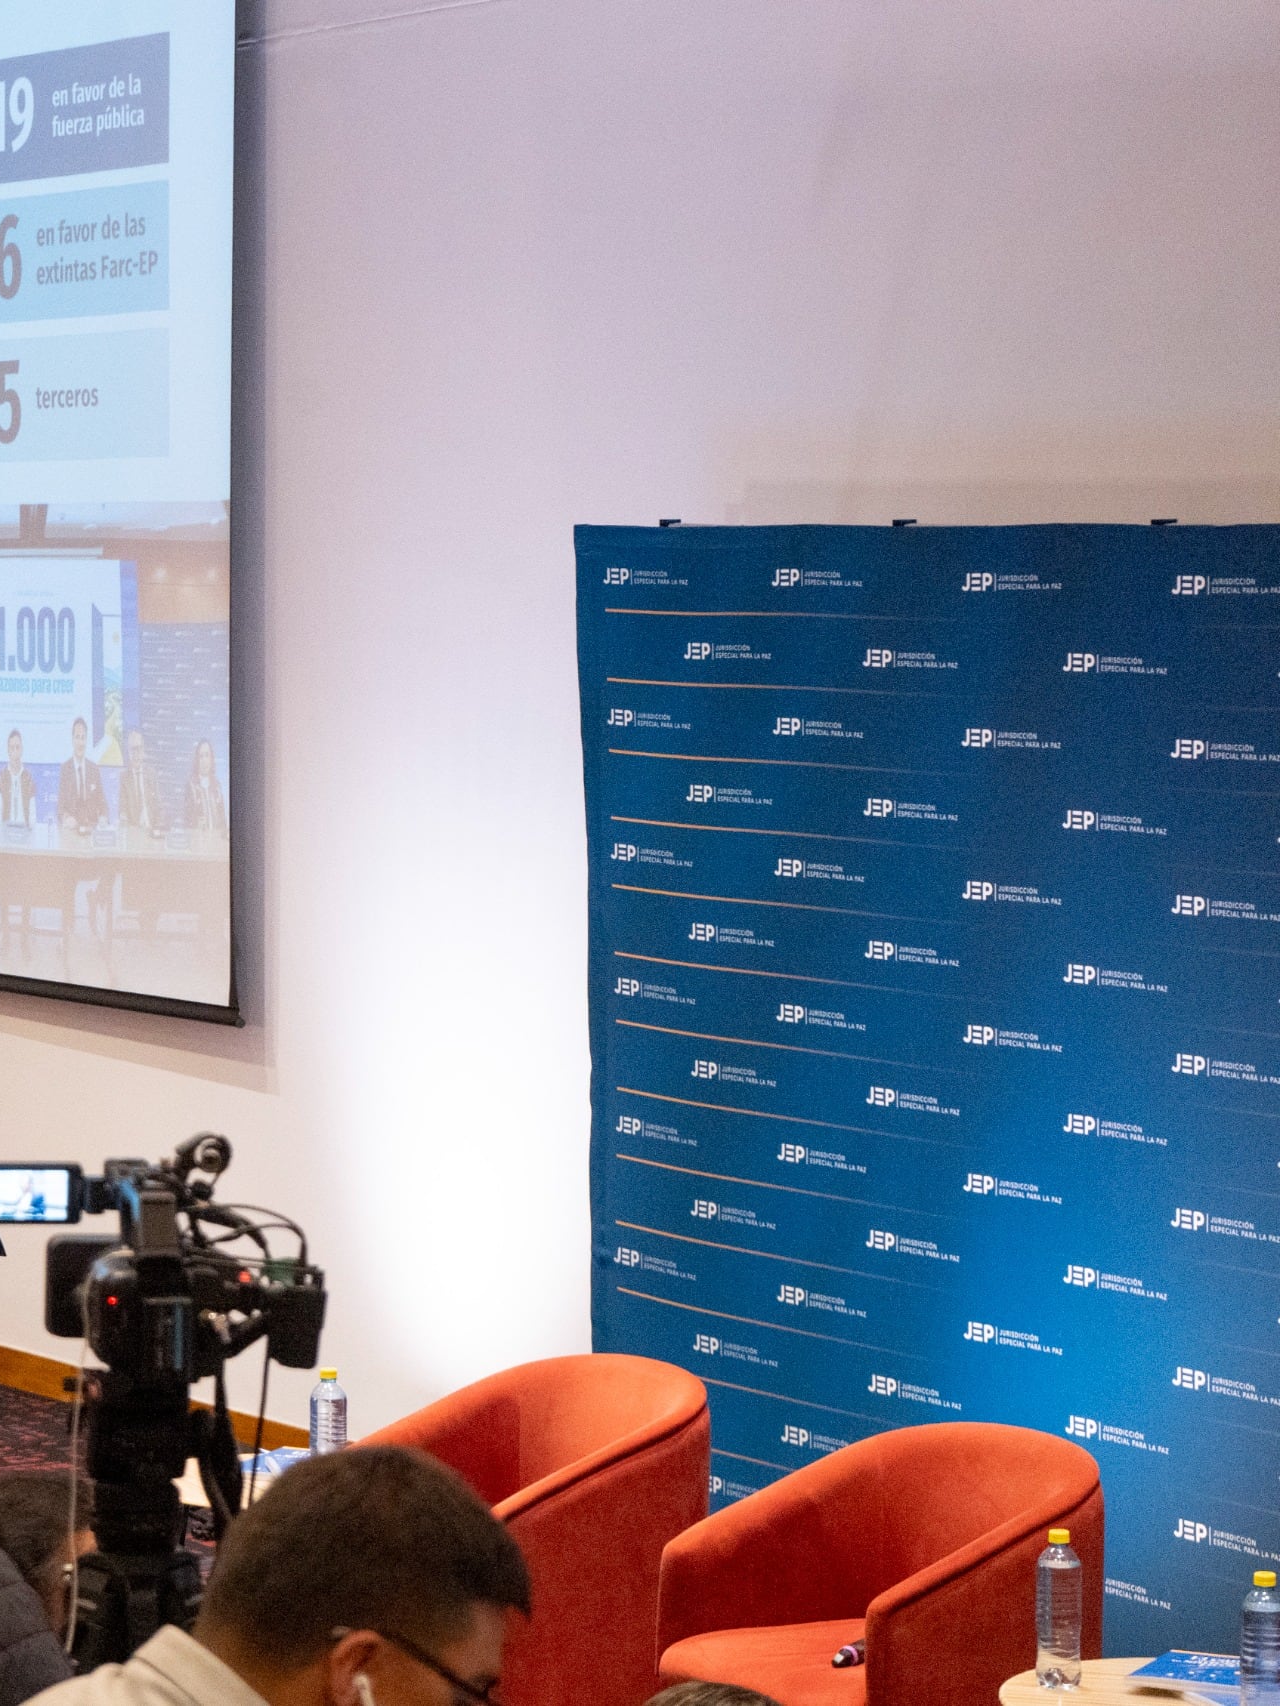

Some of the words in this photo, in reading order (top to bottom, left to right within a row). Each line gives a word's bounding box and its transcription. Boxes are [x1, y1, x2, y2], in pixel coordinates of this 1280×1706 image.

[52, 89, 68, 107] en
[71, 81, 106, 104] favor
[109, 75, 125, 98] de
[128, 73, 141, 96] la
[52, 115, 93, 138] fuerza
[96, 104, 145, 137] pública
[37, 227, 55, 246] en
[58, 219, 97, 244] favor
[101, 214, 120, 239] de
[125, 212, 145, 238] las
[37, 256, 97, 285] extintas
[101, 250, 158, 279] Farc-EP
[35, 385, 99, 410] terceros
[603, 568, 629, 585] JEP
[772, 569, 800, 586] JEP
[962, 573, 992, 591] JEP
[1172, 576, 1205, 595] JEP
[684, 643, 711, 660] JEP
[863, 649, 892, 667] JEP
[1063, 653, 1095, 672] JEP
[607, 709, 633, 726] JEP
[773, 717, 801, 735] JEP
[961, 728, 992, 747] JEP
[1171, 739, 1204, 759] JEP
[686, 785, 713, 802] JEP
[864, 798, 894, 817] JEP
[1062, 810, 1095, 830] JEP
[611, 843, 636, 861] JEP
[774, 859, 802, 877] JEP
[962, 881, 993, 900] JEP
[1171, 895, 1205, 916] JEP
[688, 923, 715, 941] JEP
[865, 941, 895, 960] JEP
[1063, 964, 1096, 985] JEP
[614, 978, 639, 996] JEP
[1101, 978, 1128, 987] ESPECIAL
[1130, 981, 1145, 989] PARA
[1156, 984, 1168, 992] PAZ
[776, 1004, 804, 1023] JEP
[963, 1025, 994, 1045] JEP
[691, 1060, 717, 1079] JEP
[1172, 1053, 1205, 1075] JEP
[866, 1086, 896, 1106] JEP
[616, 1116, 642, 1136] JEP
[1063, 1114, 1096, 1136] JEP
[777, 1143, 805, 1164] JEP
[963, 1173, 994, 1195] JEP
[691, 1200, 718, 1219] JEP
[1171, 1208, 1205, 1231] JEP
[866, 1230, 896, 1251] JEP
[614, 1247, 639, 1266] JEP
[1063, 1265, 1096, 1288] JEP
[777, 1285, 805, 1306] JEP
[1100, 1282, 1128, 1292] ESPECIAL
[1130, 1287, 1145, 1296] PARA
[1147, 1290, 1155, 1298] LA
[1156, 1292, 1168, 1301] PAZ
[964, 1322, 995, 1343] JEP
[693, 1334, 720, 1354] JEP
[1000, 1337, 1026, 1348] ESPECIAL
[1027, 1342, 1041, 1351] PARA
[1051, 1346, 1063, 1355] PAZ
[868, 1374, 898, 1396] JEP
[1172, 1367, 1206, 1390] JEP
[902, 1391, 926, 1402] ESPECIAL
[928, 1397, 941, 1407] PARA
[951, 1402, 961, 1411] PAZ
[781, 1425, 809, 1448] JEP
[1066, 1416, 1096, 1440] JEP
[1102, 1433, 1130, 1446] ESPECIAL
[1132, 1440, 1147, 1450] PARA
[1157, 1446, 1169, 1455] PAZ
[1174, 1519, 1207, 1543] JEP
[1213, 1538, 1241, 1551] ESPECIAL
[1243, 1546, 1259, 1556] PARA
[1261, 1549, 1268, 1557] LA
[1105, 1586, 1132, 1600] ESPECIAL
[1134, 1594, 1149, 1604] PARA
[1150, 1598, 1158, 1606] LA
[1159, 1600, 1171, 1610] PAZ
